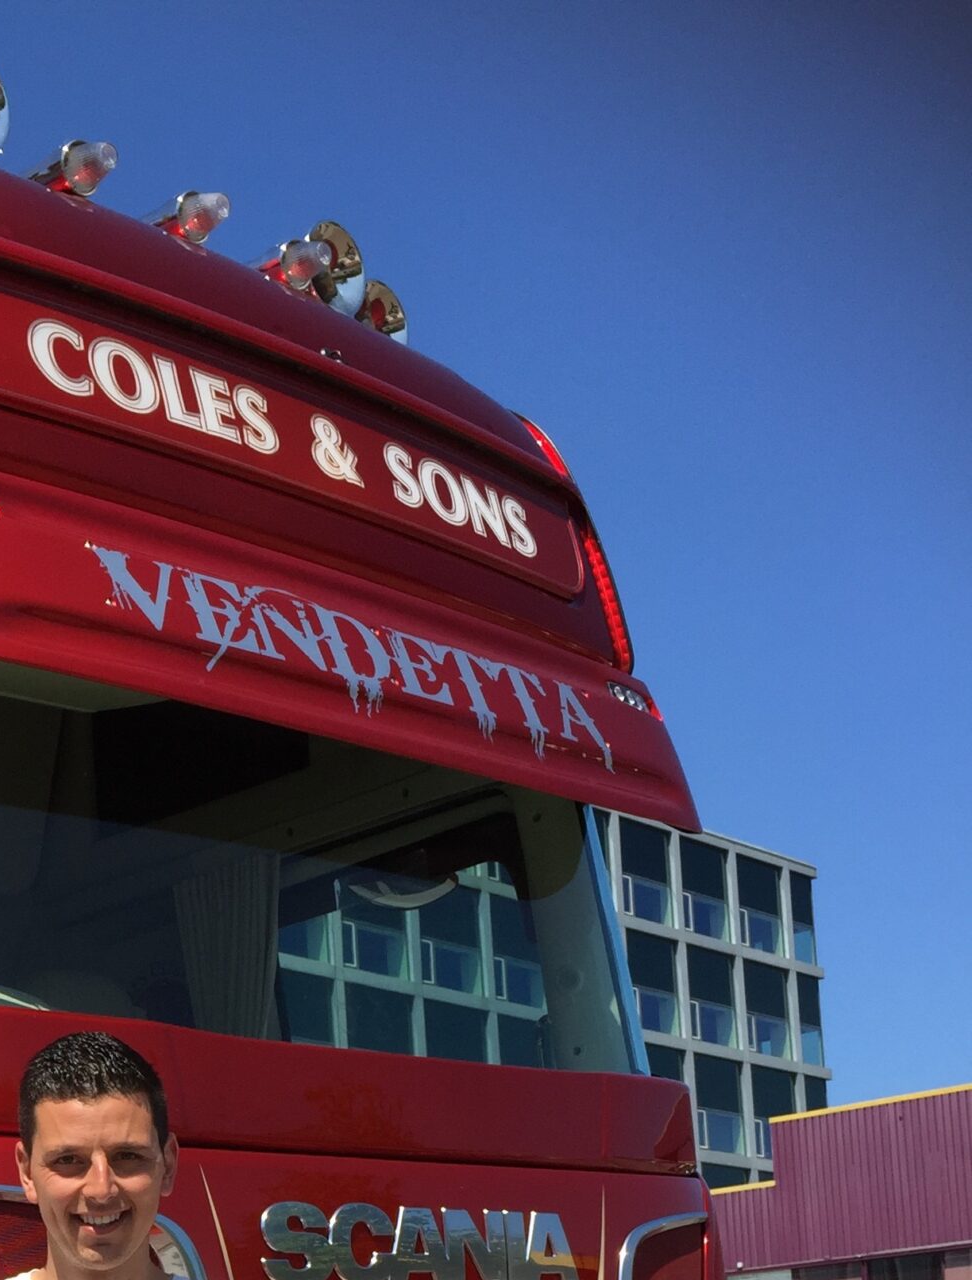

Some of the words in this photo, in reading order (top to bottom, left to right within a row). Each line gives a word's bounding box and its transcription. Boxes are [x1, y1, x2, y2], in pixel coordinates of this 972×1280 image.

[28, 318, 279, 455] COLES
[310, 414, 364, 488] &
[383, 441, 538, 558] SONS
[87, 543, 615, 774] VENDETTA
